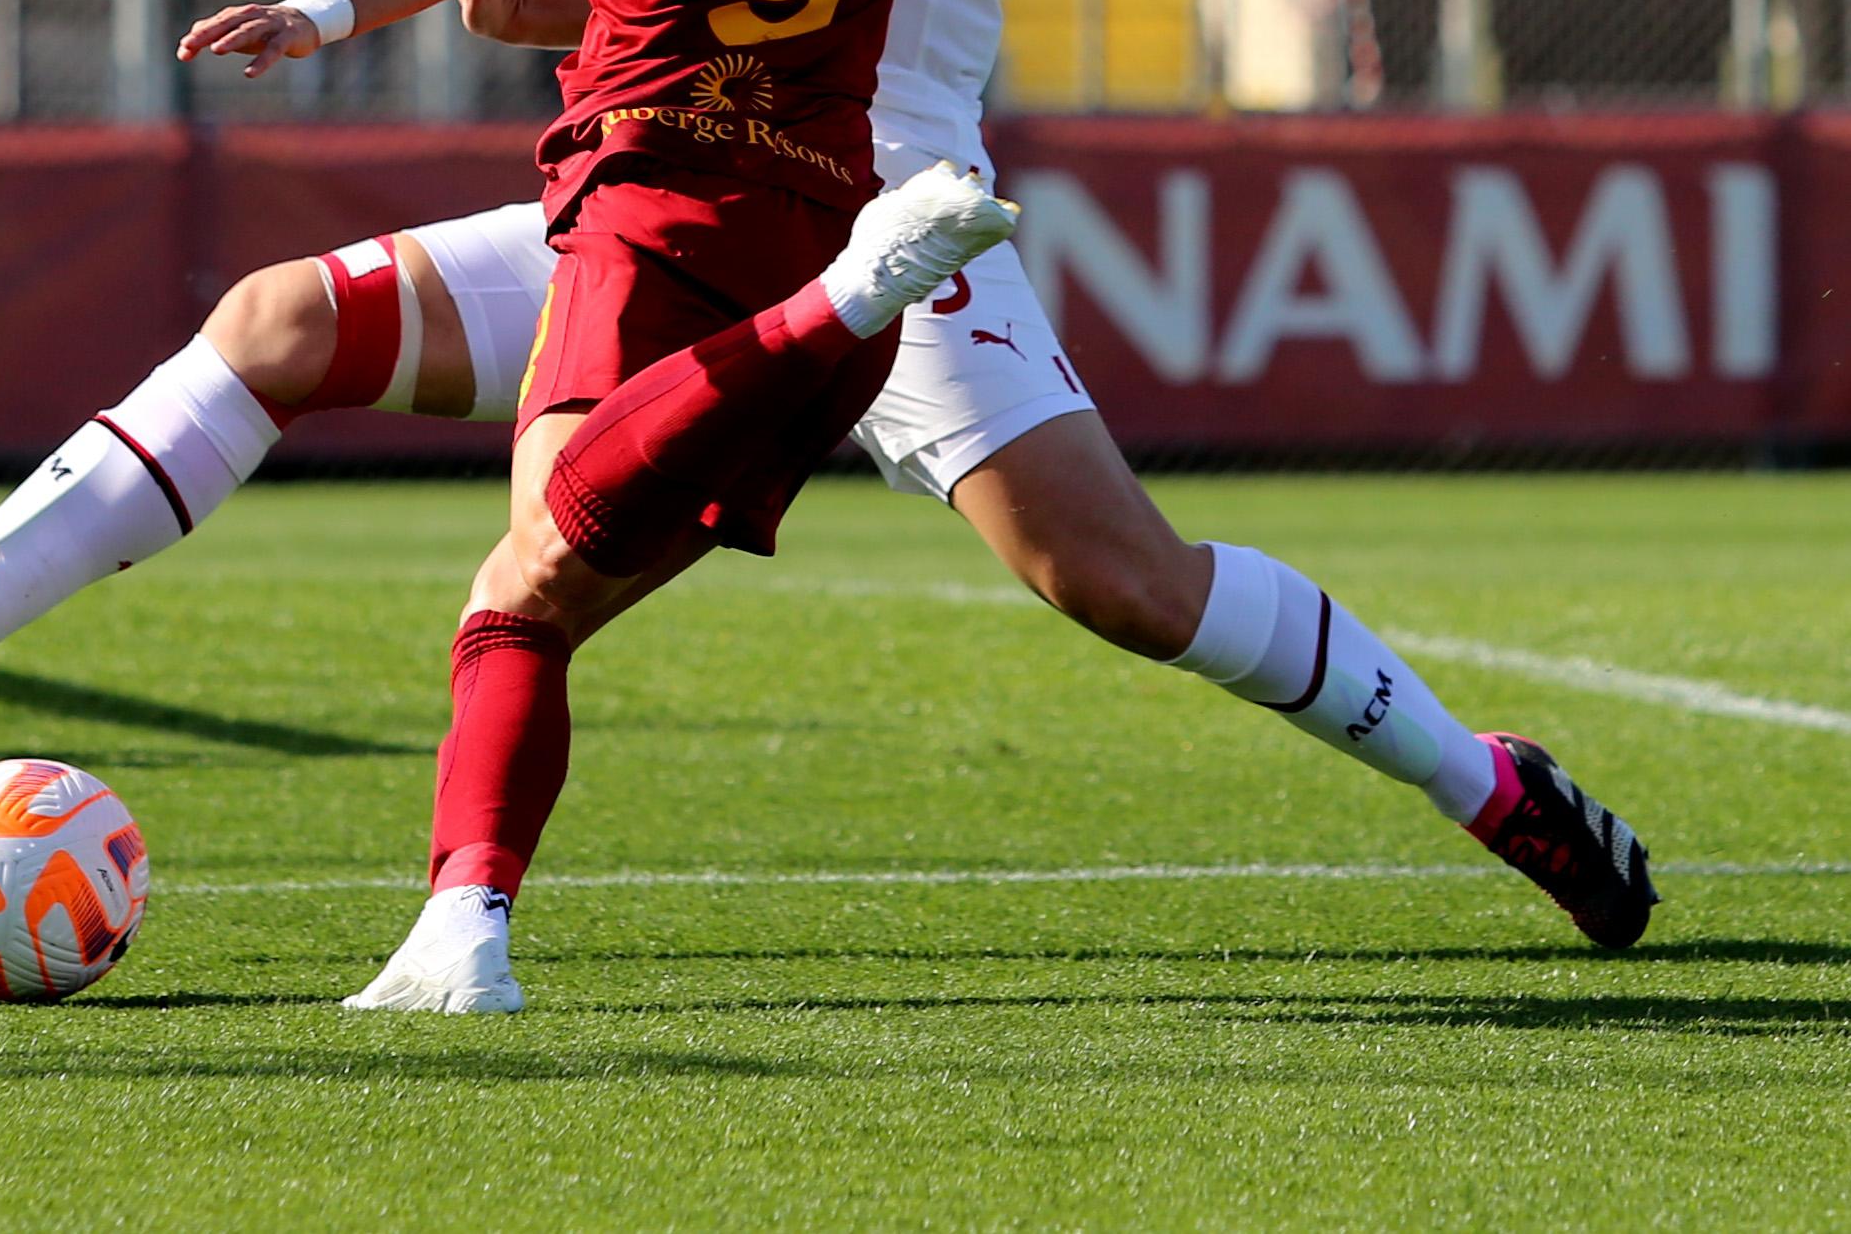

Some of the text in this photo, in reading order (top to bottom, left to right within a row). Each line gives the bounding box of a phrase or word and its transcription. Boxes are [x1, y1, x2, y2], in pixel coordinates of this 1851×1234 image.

[746, 118, 854, 186] Resorts
[1015, 166, 1781, 382] NAMI
[1346, 667, 1393, 742] ACM
